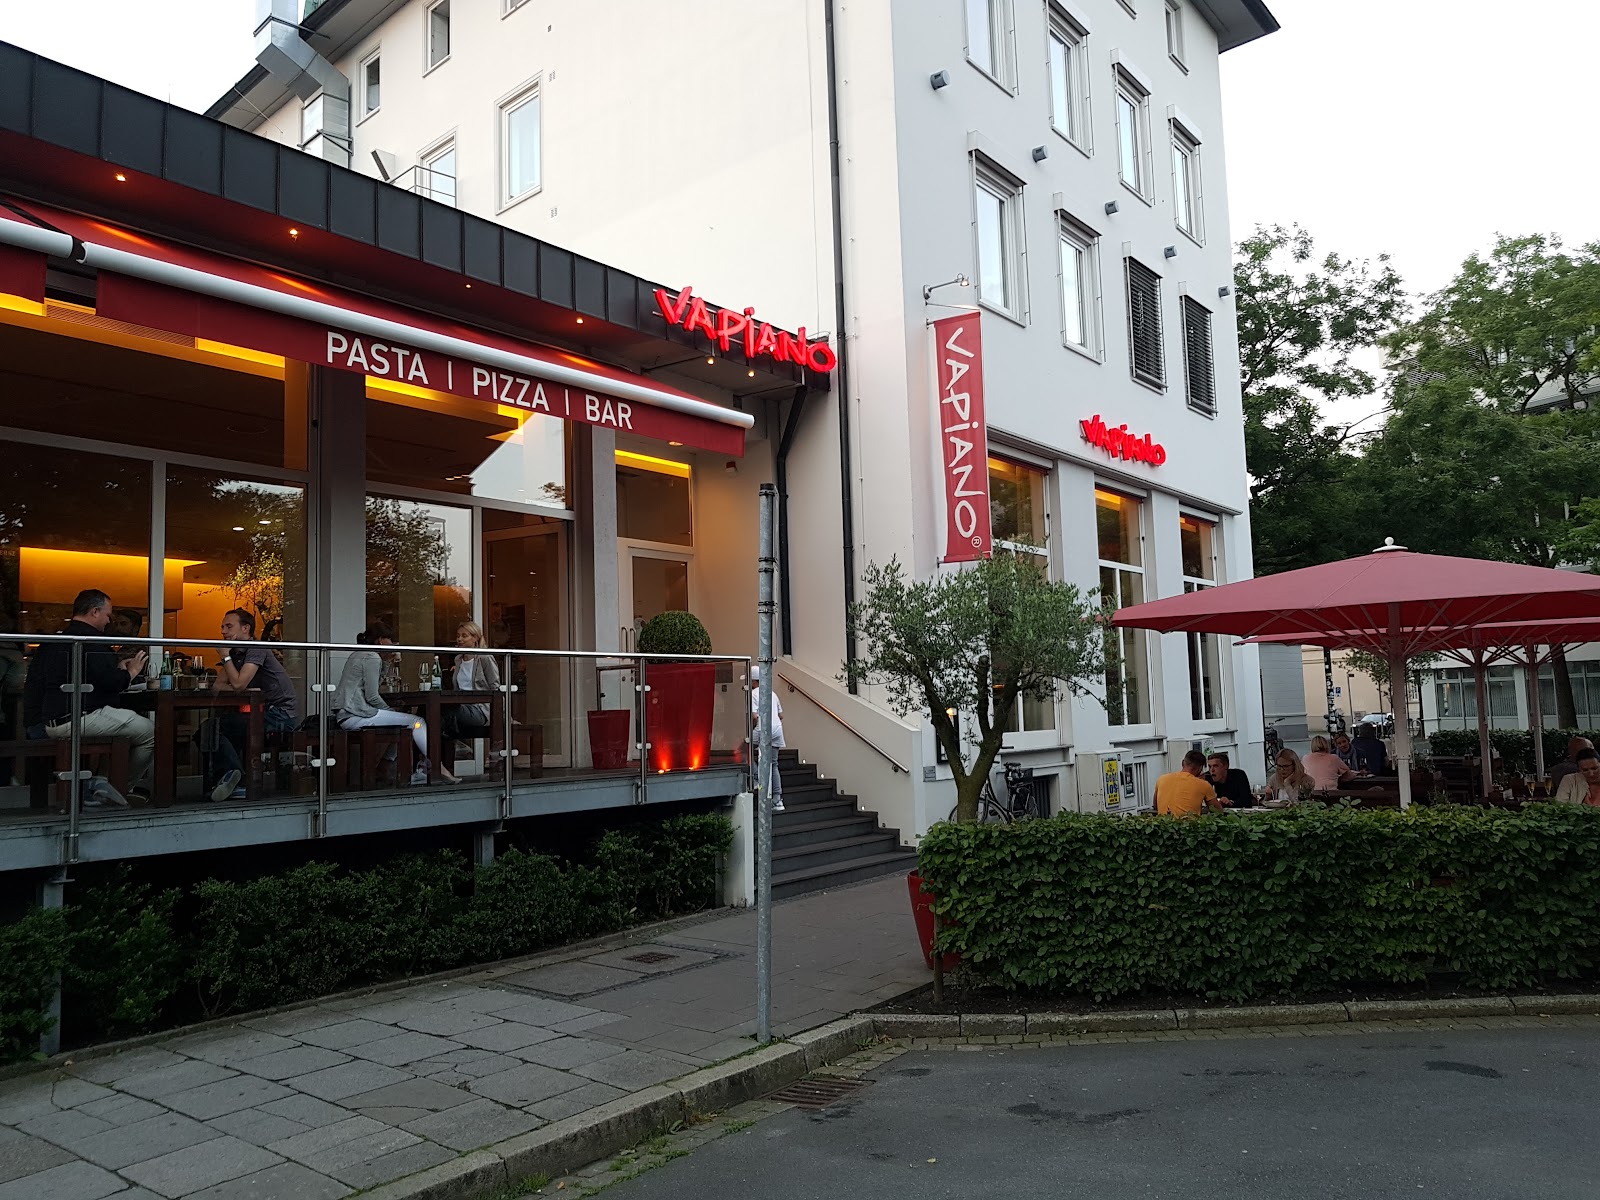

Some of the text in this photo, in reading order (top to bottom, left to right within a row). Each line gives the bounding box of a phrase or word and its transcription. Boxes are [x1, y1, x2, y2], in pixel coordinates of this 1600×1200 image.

[326, 331, 430, 385] PASTA
[473, 367, 551, 412] PIZZA
[585, 394, 633, 430] BAR
